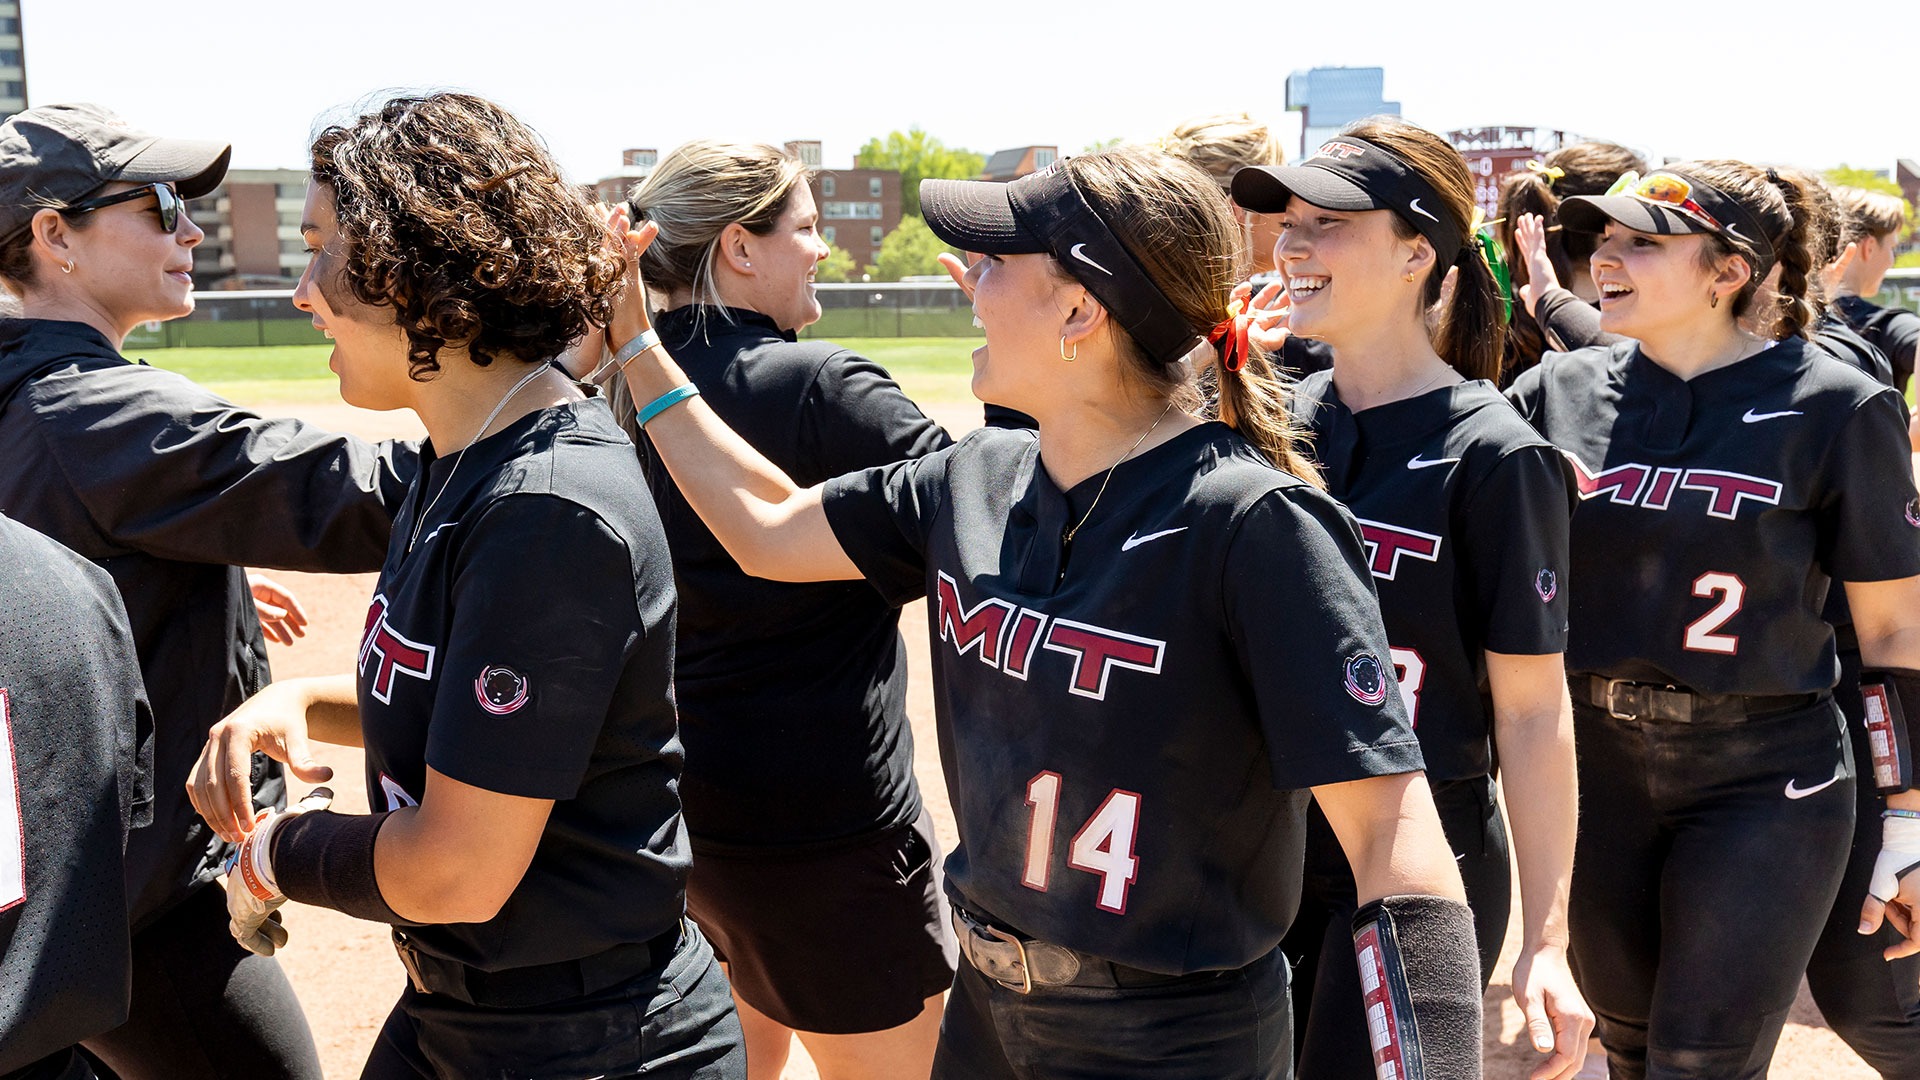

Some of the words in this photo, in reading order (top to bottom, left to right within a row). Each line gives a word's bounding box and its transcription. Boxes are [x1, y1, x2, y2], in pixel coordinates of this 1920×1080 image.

[937, 569, 1167, 701] MIT
[1683, 570, 1747, 656] 2
[1020, 769, 1142, 915] 14
